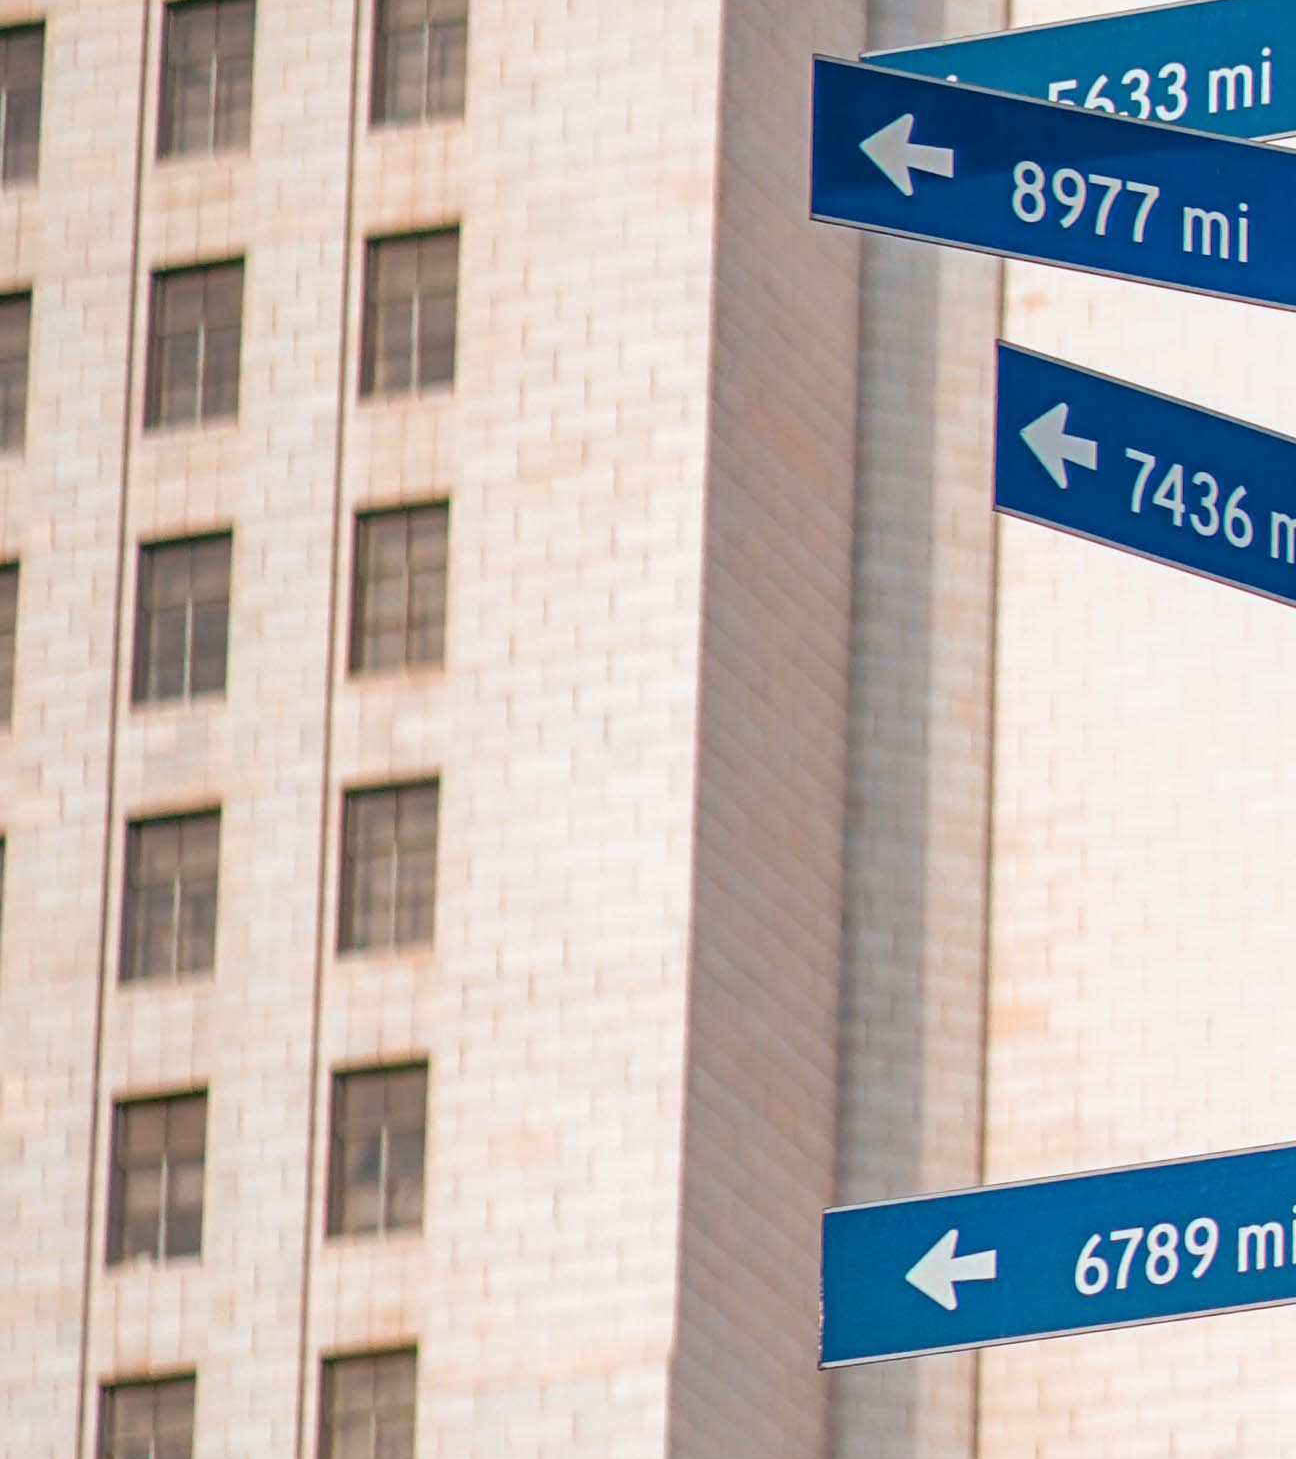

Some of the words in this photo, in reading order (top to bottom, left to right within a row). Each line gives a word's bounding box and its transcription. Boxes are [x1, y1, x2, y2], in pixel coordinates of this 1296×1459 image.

[1209, 46, 1272, 114] mi
[1013, 160, 1161, 243] 8977
[1183, 202, 1249, 263] mi
[1126, 448, 1254, 548] 7436
[1074, 1217, 1220, 1296] 6789
